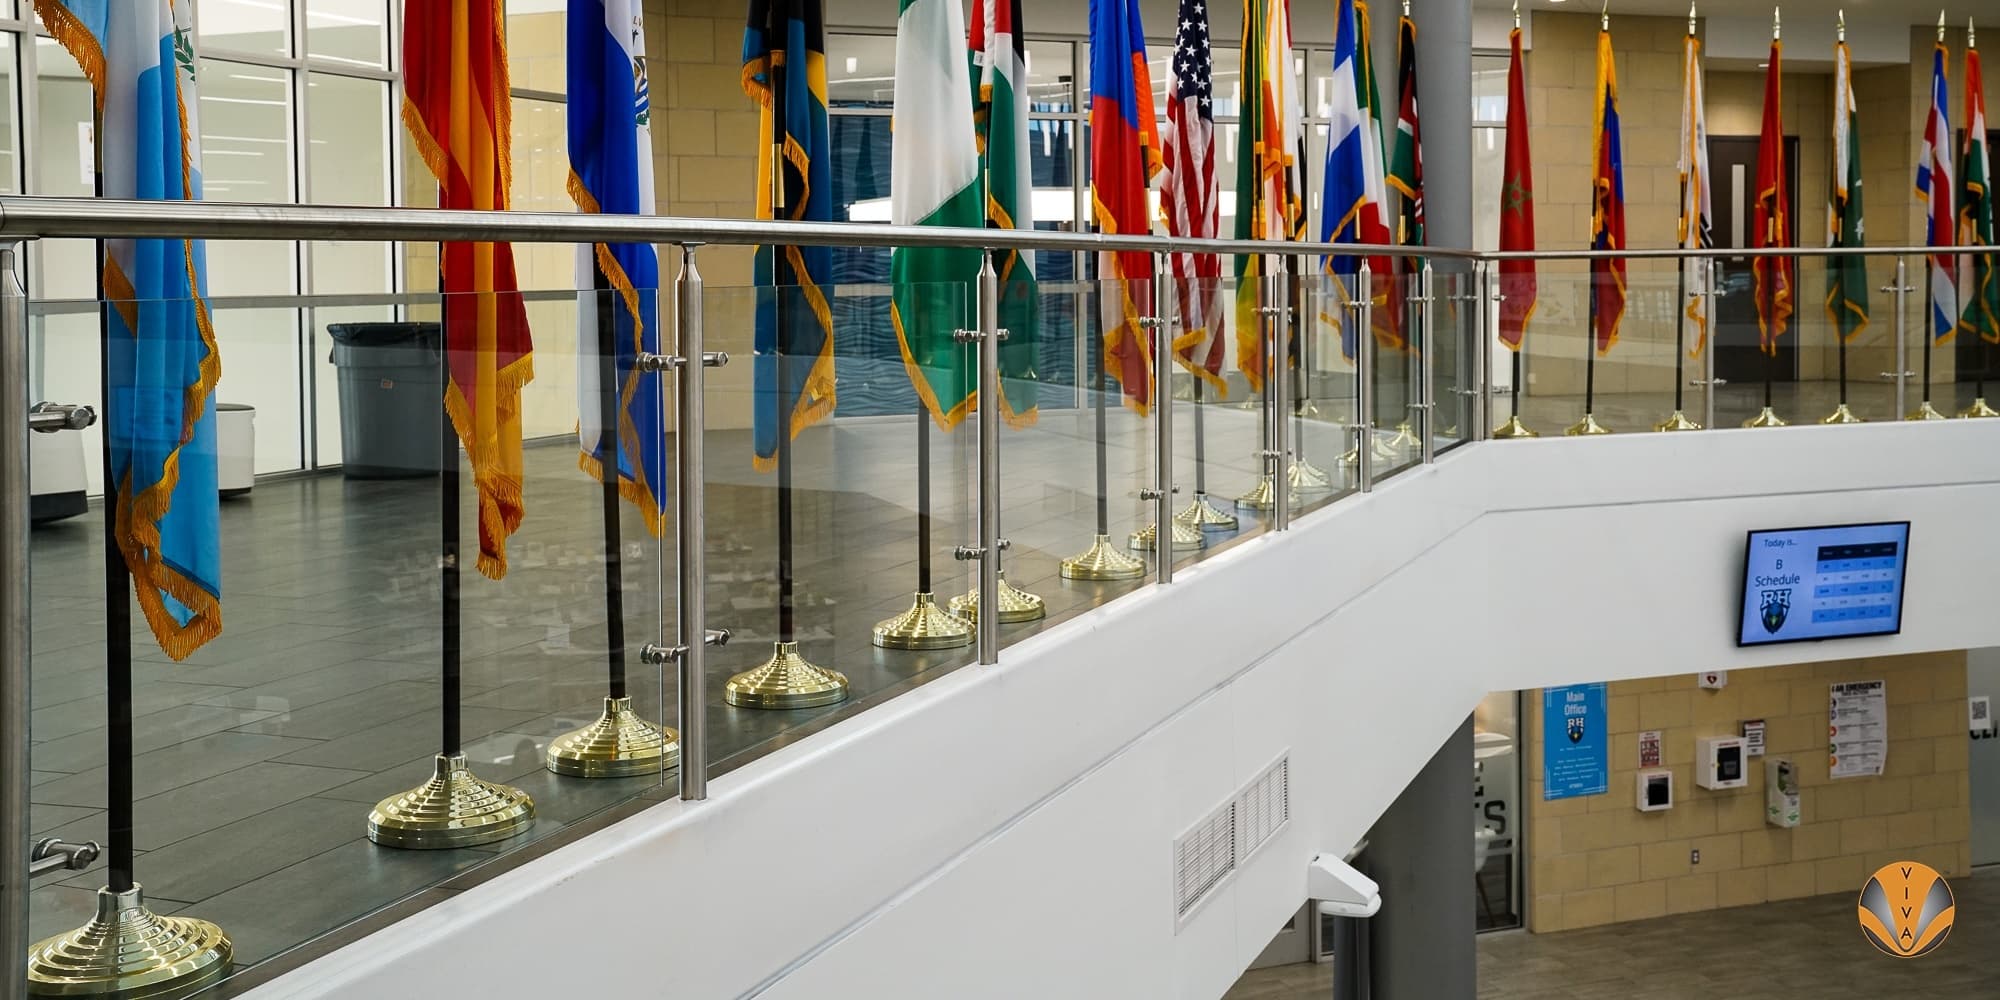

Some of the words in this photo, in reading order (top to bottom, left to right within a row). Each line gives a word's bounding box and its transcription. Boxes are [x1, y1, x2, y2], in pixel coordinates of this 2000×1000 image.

[1764, 539, 1785, 548] Today
[1776, 559, 1783, 570] B
[1755, 573, 1800, 587] Schedule
[1761, 589, 1792, 608] RH
[1566, 691, 1585, 702] Main
[1564, 703, 1587, 716] Office
[1567, 717, 1584, 729] RH
